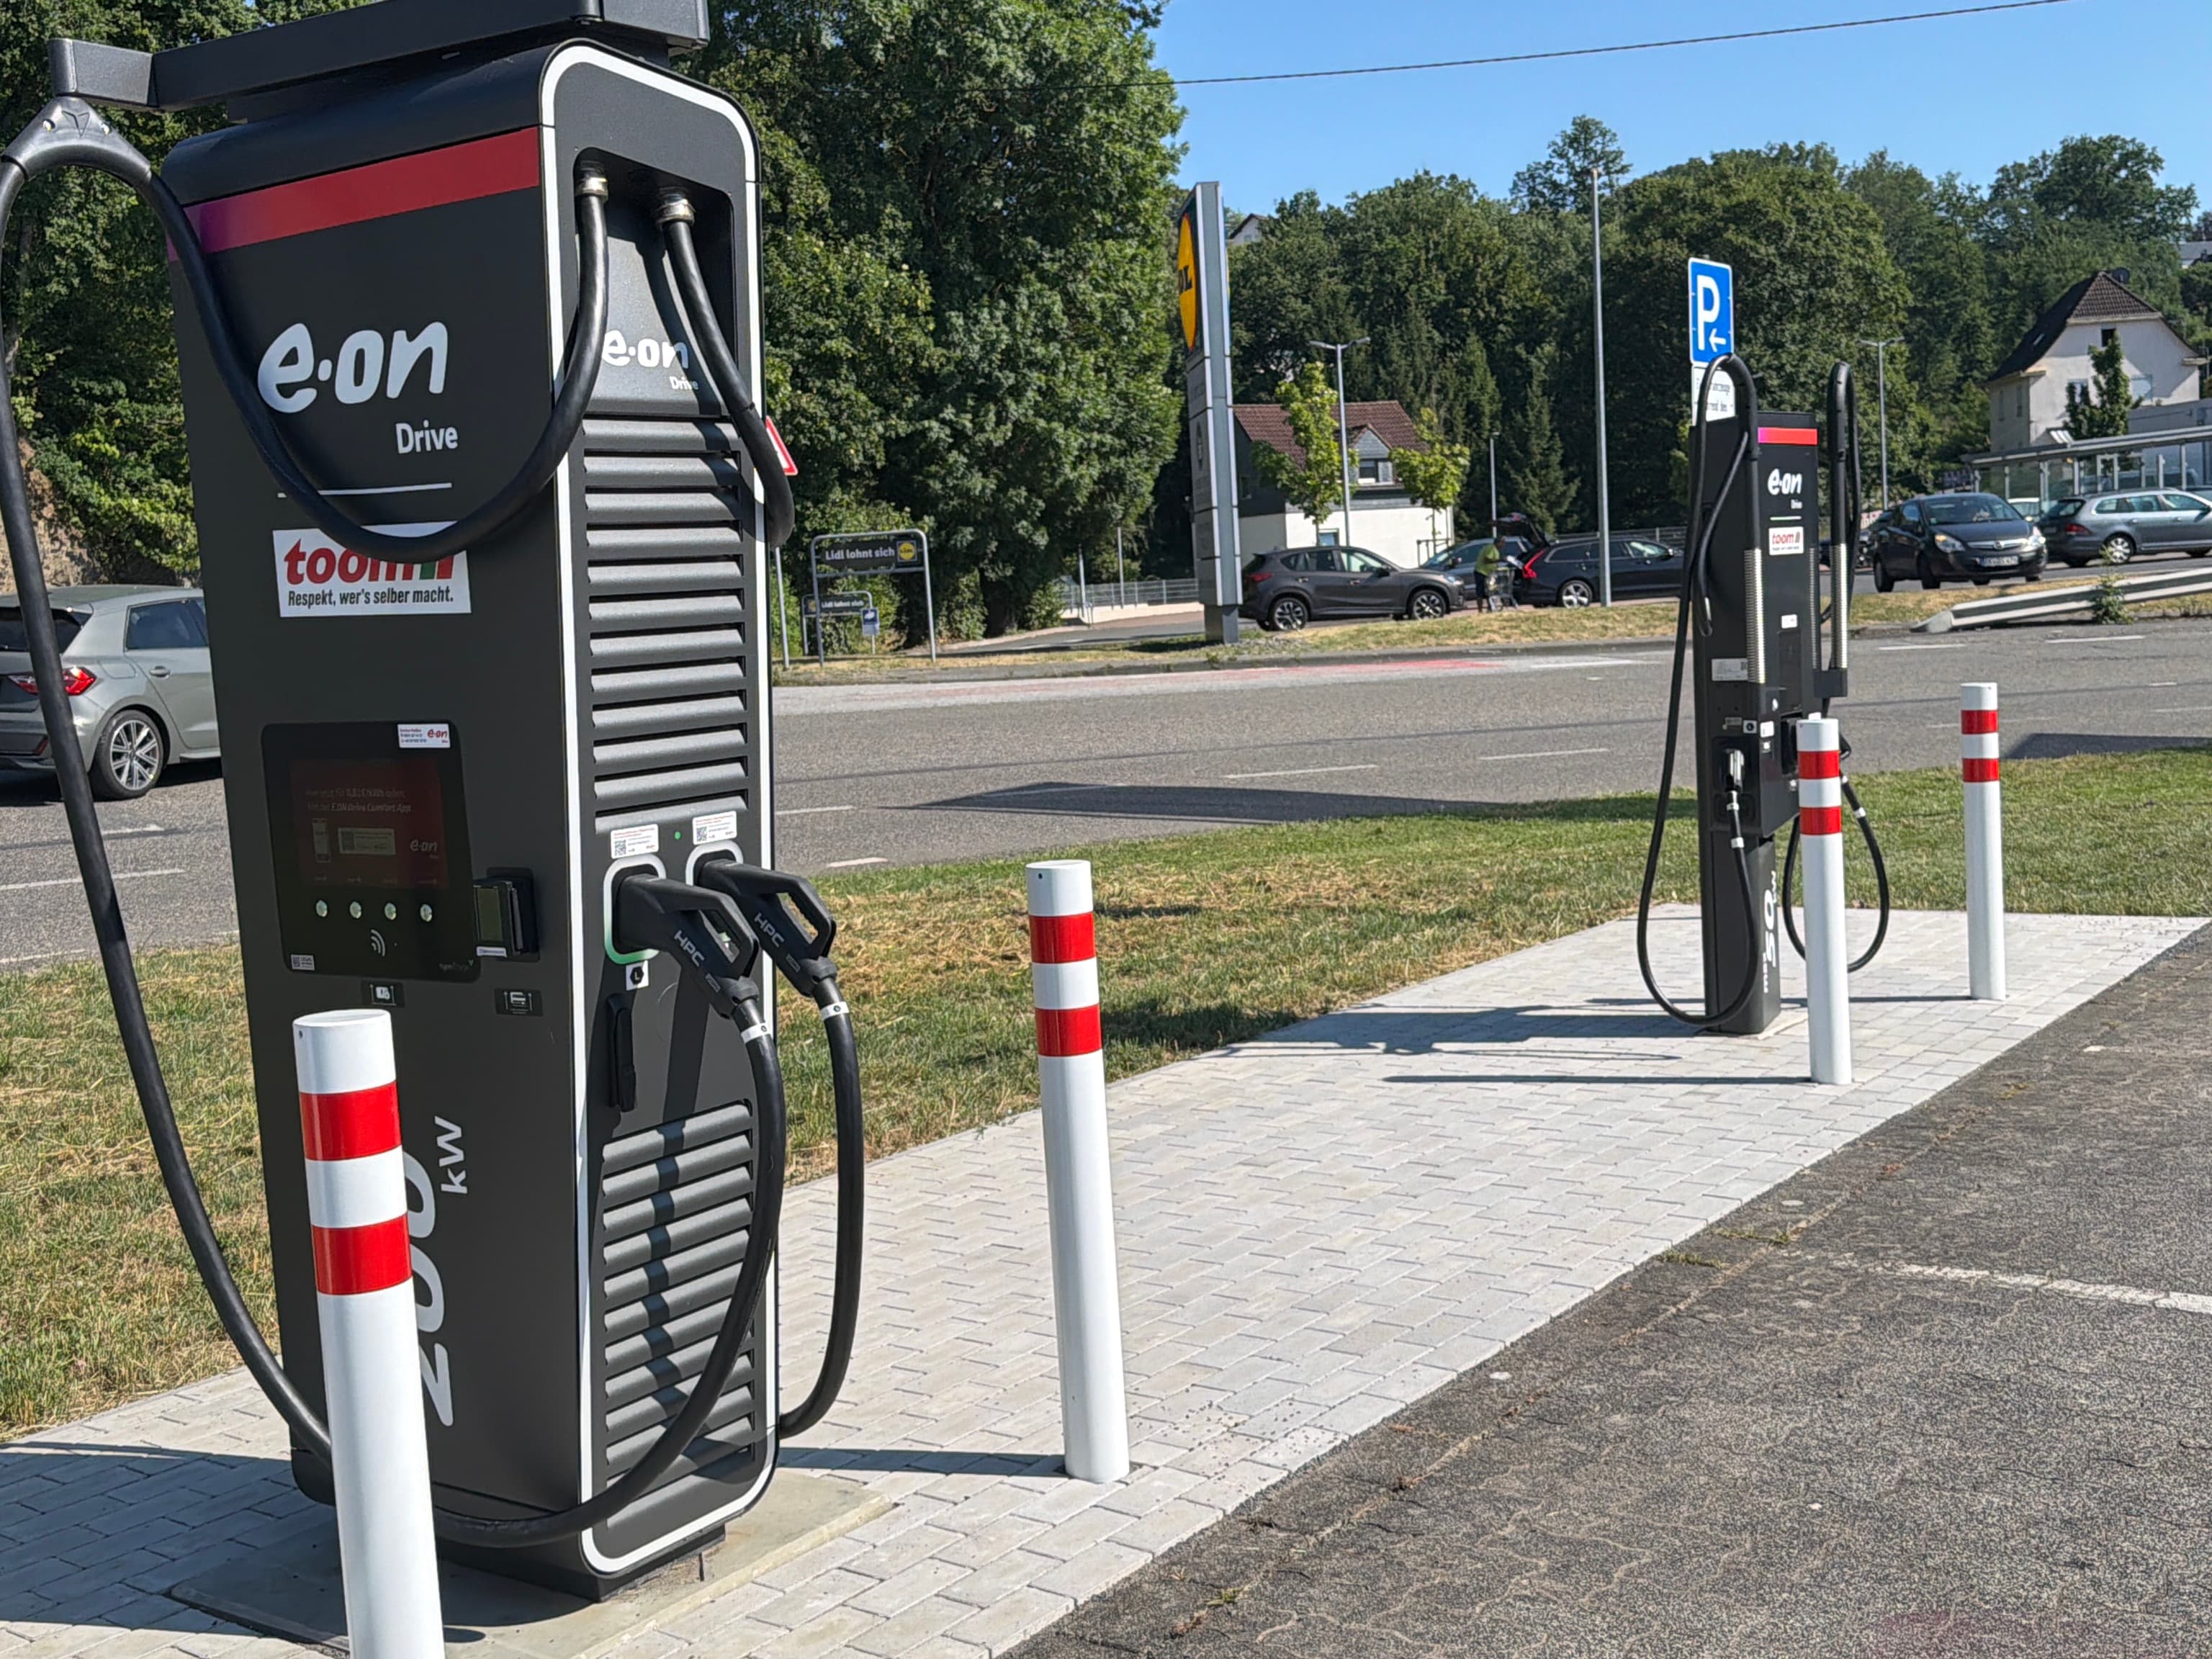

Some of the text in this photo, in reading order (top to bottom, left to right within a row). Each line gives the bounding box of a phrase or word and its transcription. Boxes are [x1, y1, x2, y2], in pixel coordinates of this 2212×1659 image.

[1696, 274, 1720, 351] P
[669, 377, 699, 390] Drive
[397, 421, 459, 454] Drive
[825, 547, 895, 561] Lidl lohnt sich
[287, 586, 454, 609] Respekt, wer's selber macht.
[754, 912, 785, 948] HPC
[674, 930, 705, 967] HPC
[434, 1115, 469, 1195] kW
